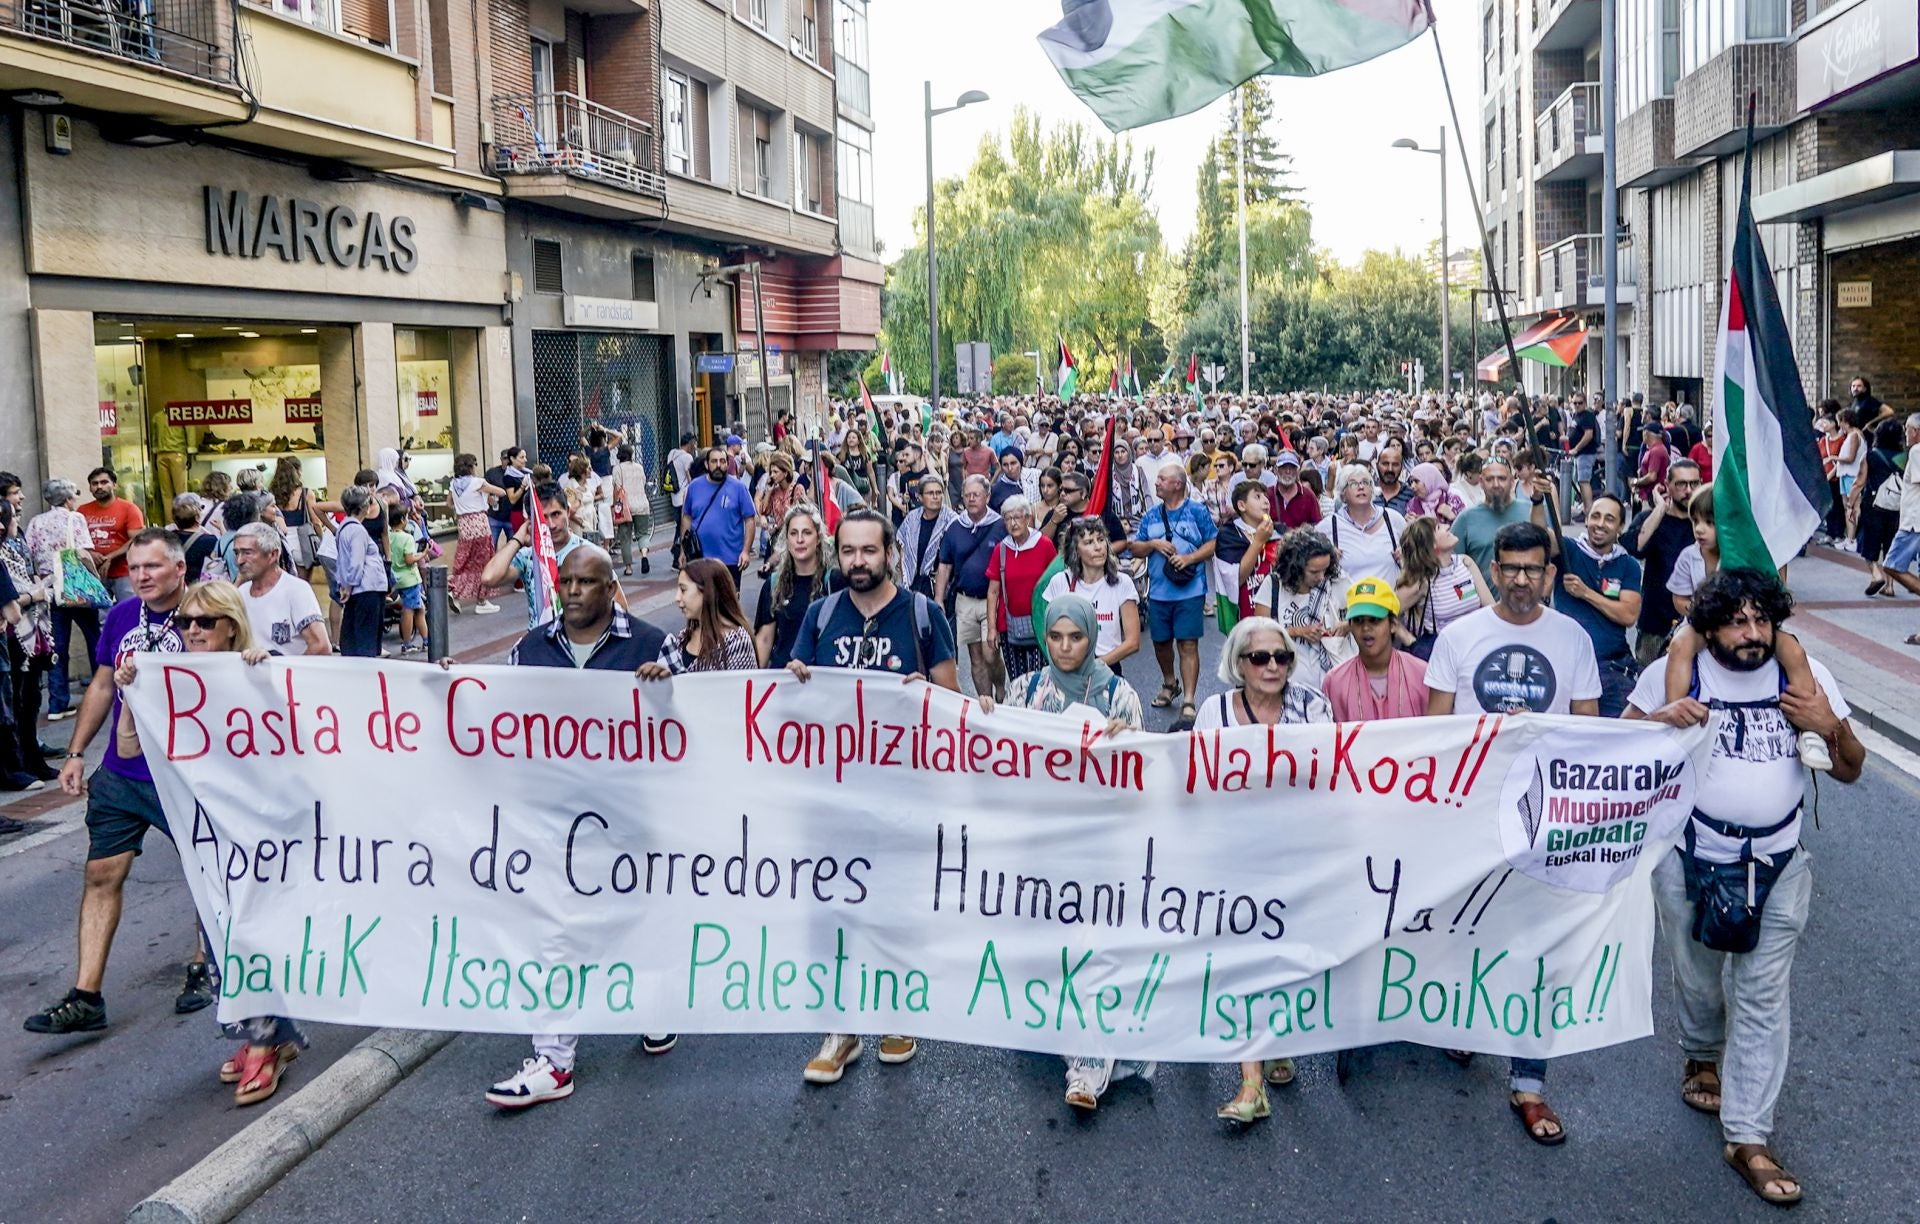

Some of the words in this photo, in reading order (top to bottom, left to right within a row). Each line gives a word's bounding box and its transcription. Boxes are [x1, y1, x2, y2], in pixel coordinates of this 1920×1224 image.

[203, 184, 419, 274] MARCAS
[596, 302, 633, 321] randstad
[168, 404, 251, 421] REBAJAS
[163, 665, 342, 762] Basta
[367, 671, 422, 754] de
[446, 677, 688, 763] Genocidio
[1549, 758, 1686, 792] Gazarako
[1546, 820, 1648, 853] Globala
[192, 796, 436, 906] Apertura
[469, 804, 532, 894] de
[565, 811, 872, 904] Corredores
[933, 823, 1287, 940] Humanitarios
[1545, 847, 1596, 868] Euskal
[421, 914, 635, 1012] Itsasora
[688, 922, 930, 1013] Palestina
[1199, 952, 1334, 1041] Israel
